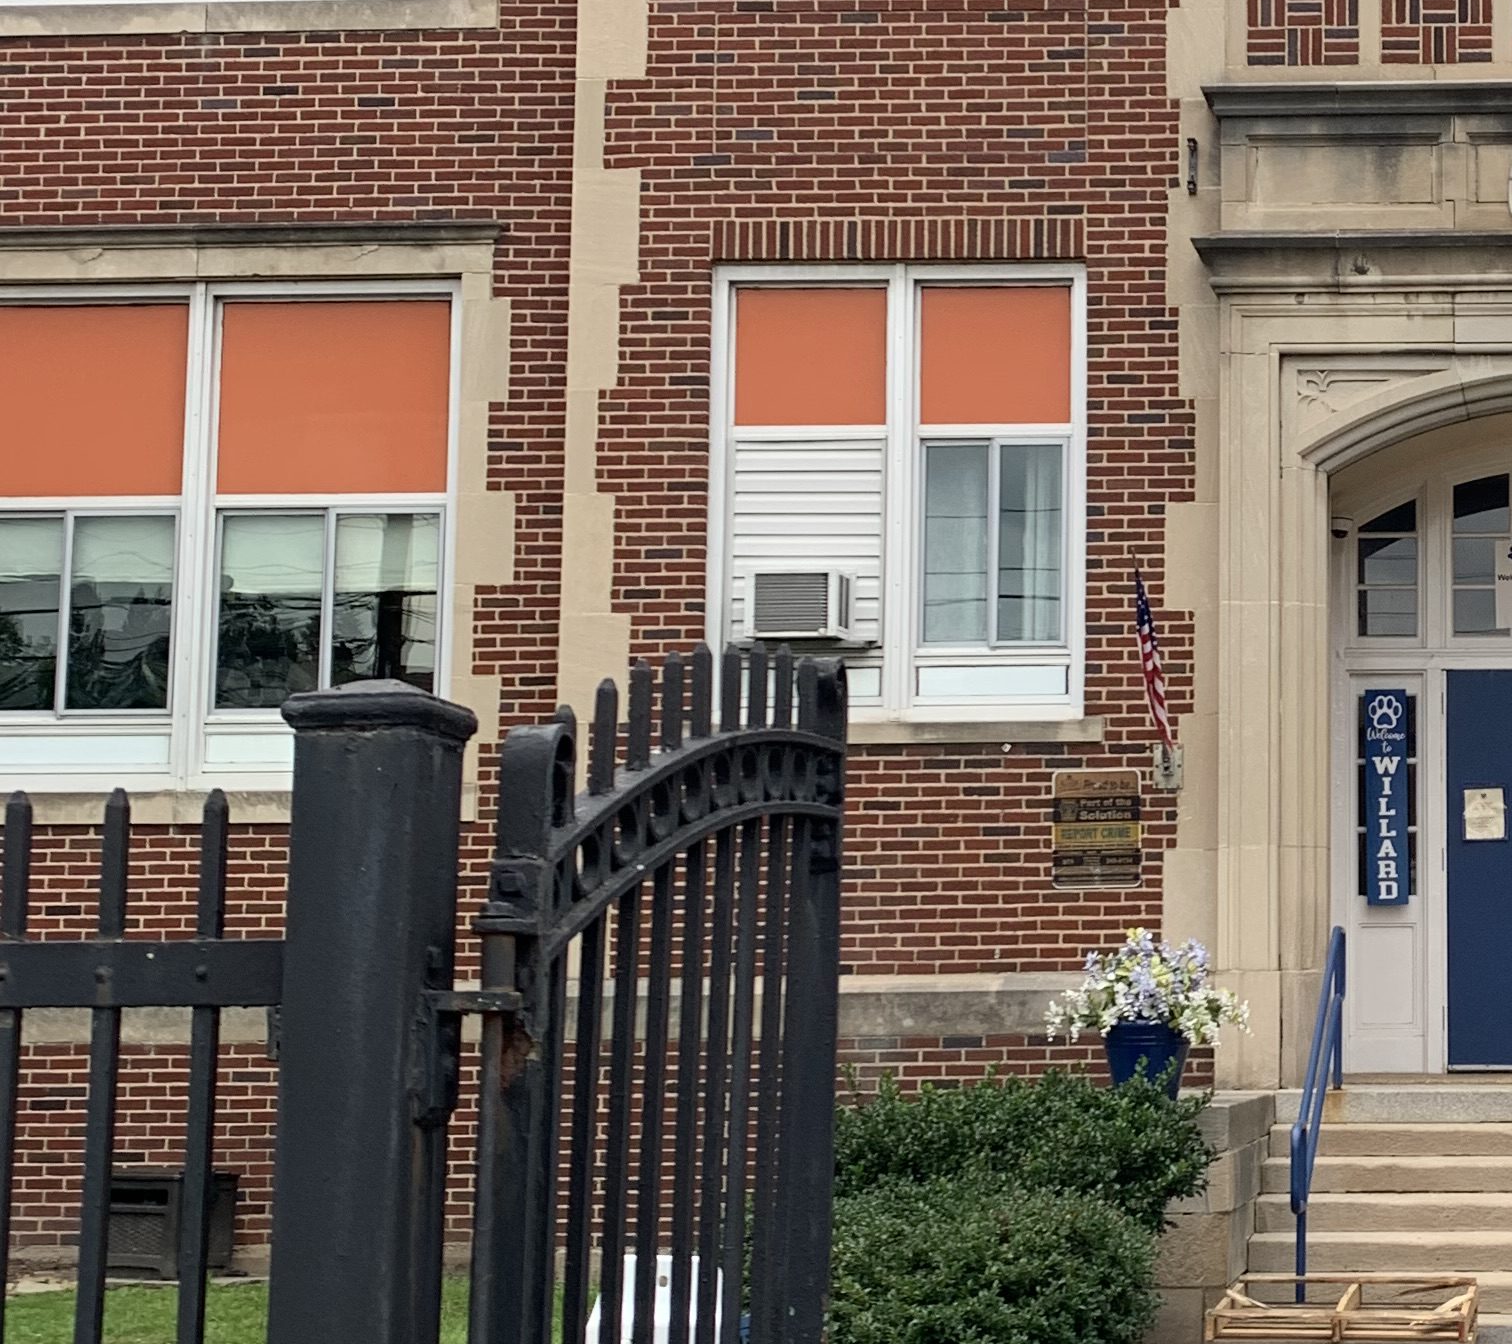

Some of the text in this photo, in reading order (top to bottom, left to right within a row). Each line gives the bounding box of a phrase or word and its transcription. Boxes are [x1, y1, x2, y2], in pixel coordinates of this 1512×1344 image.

[1366, 727, 1406, 741] Welcome
[1382, 741, 1392, 754] to
[1080, 799, 1101, 807] Part
[1103, 798, 1114, 806] of
[1079, 810, 1132, 820] Solution
[1372, 756, 1401, 900] WILLARD
